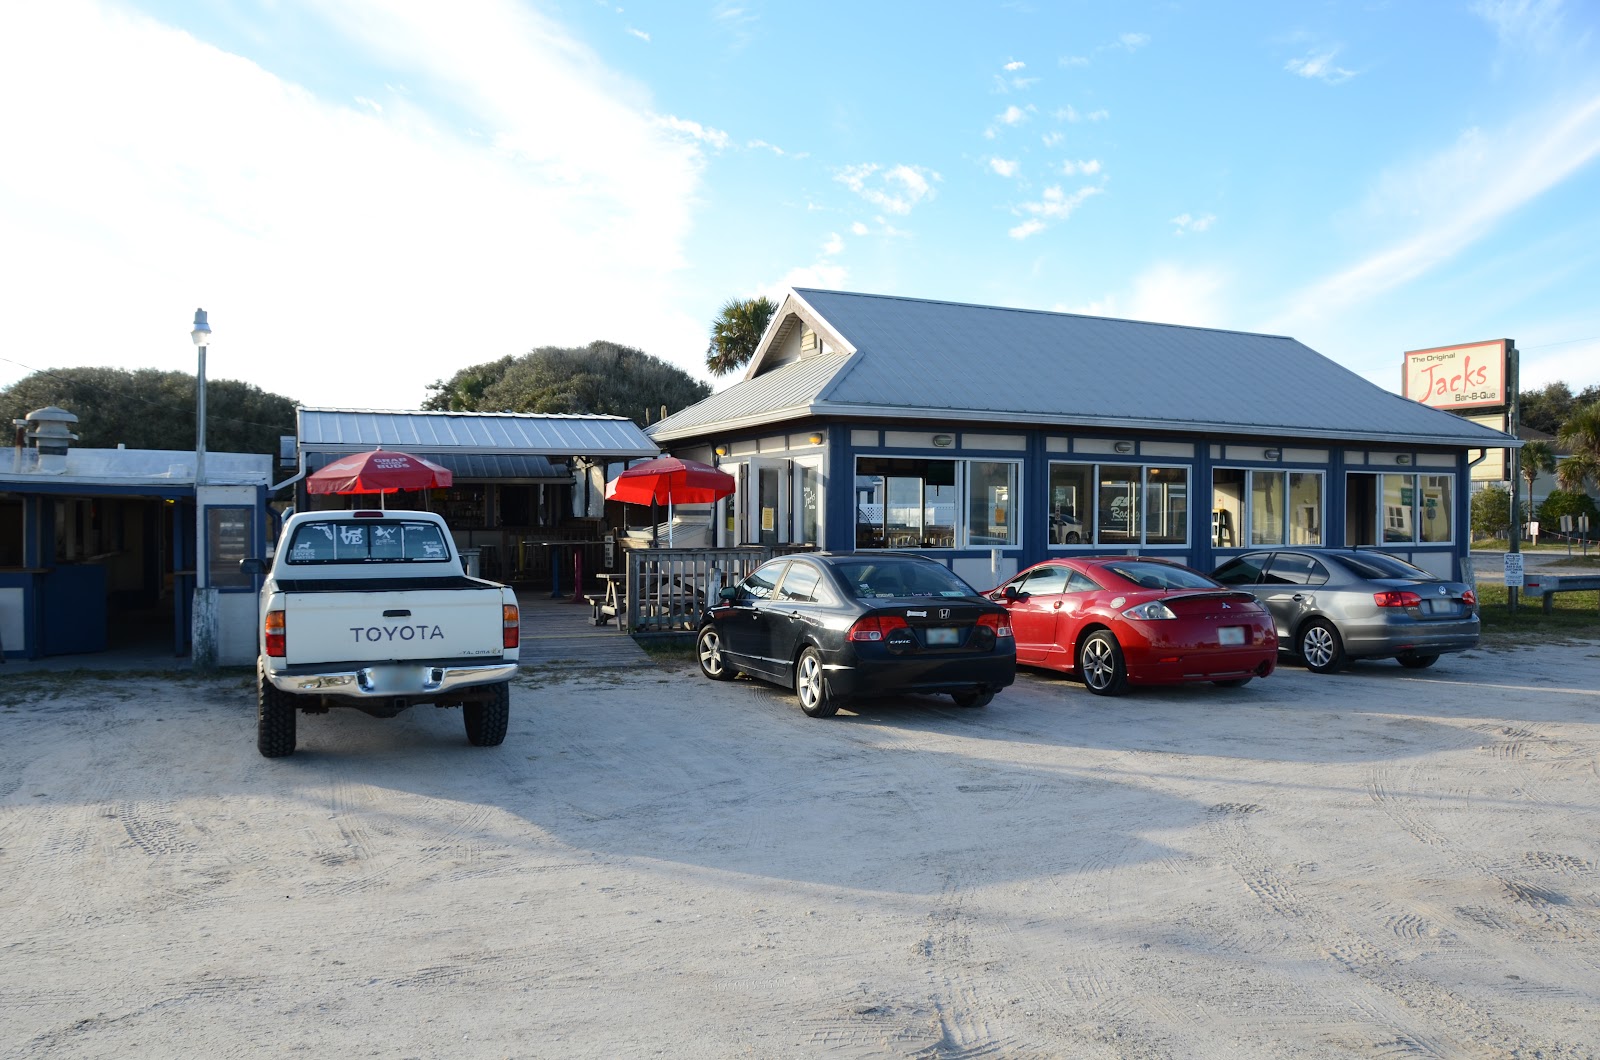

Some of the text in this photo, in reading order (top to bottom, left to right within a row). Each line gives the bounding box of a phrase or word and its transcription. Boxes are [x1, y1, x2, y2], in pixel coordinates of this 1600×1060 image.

[1426, 353, 1456, 362] Original
[1418, 355, 1487, 403] Jacks
[1454, 391, 1496, 402] Bar-B-Que
[350, 625, 444, 643] TOYOTA
